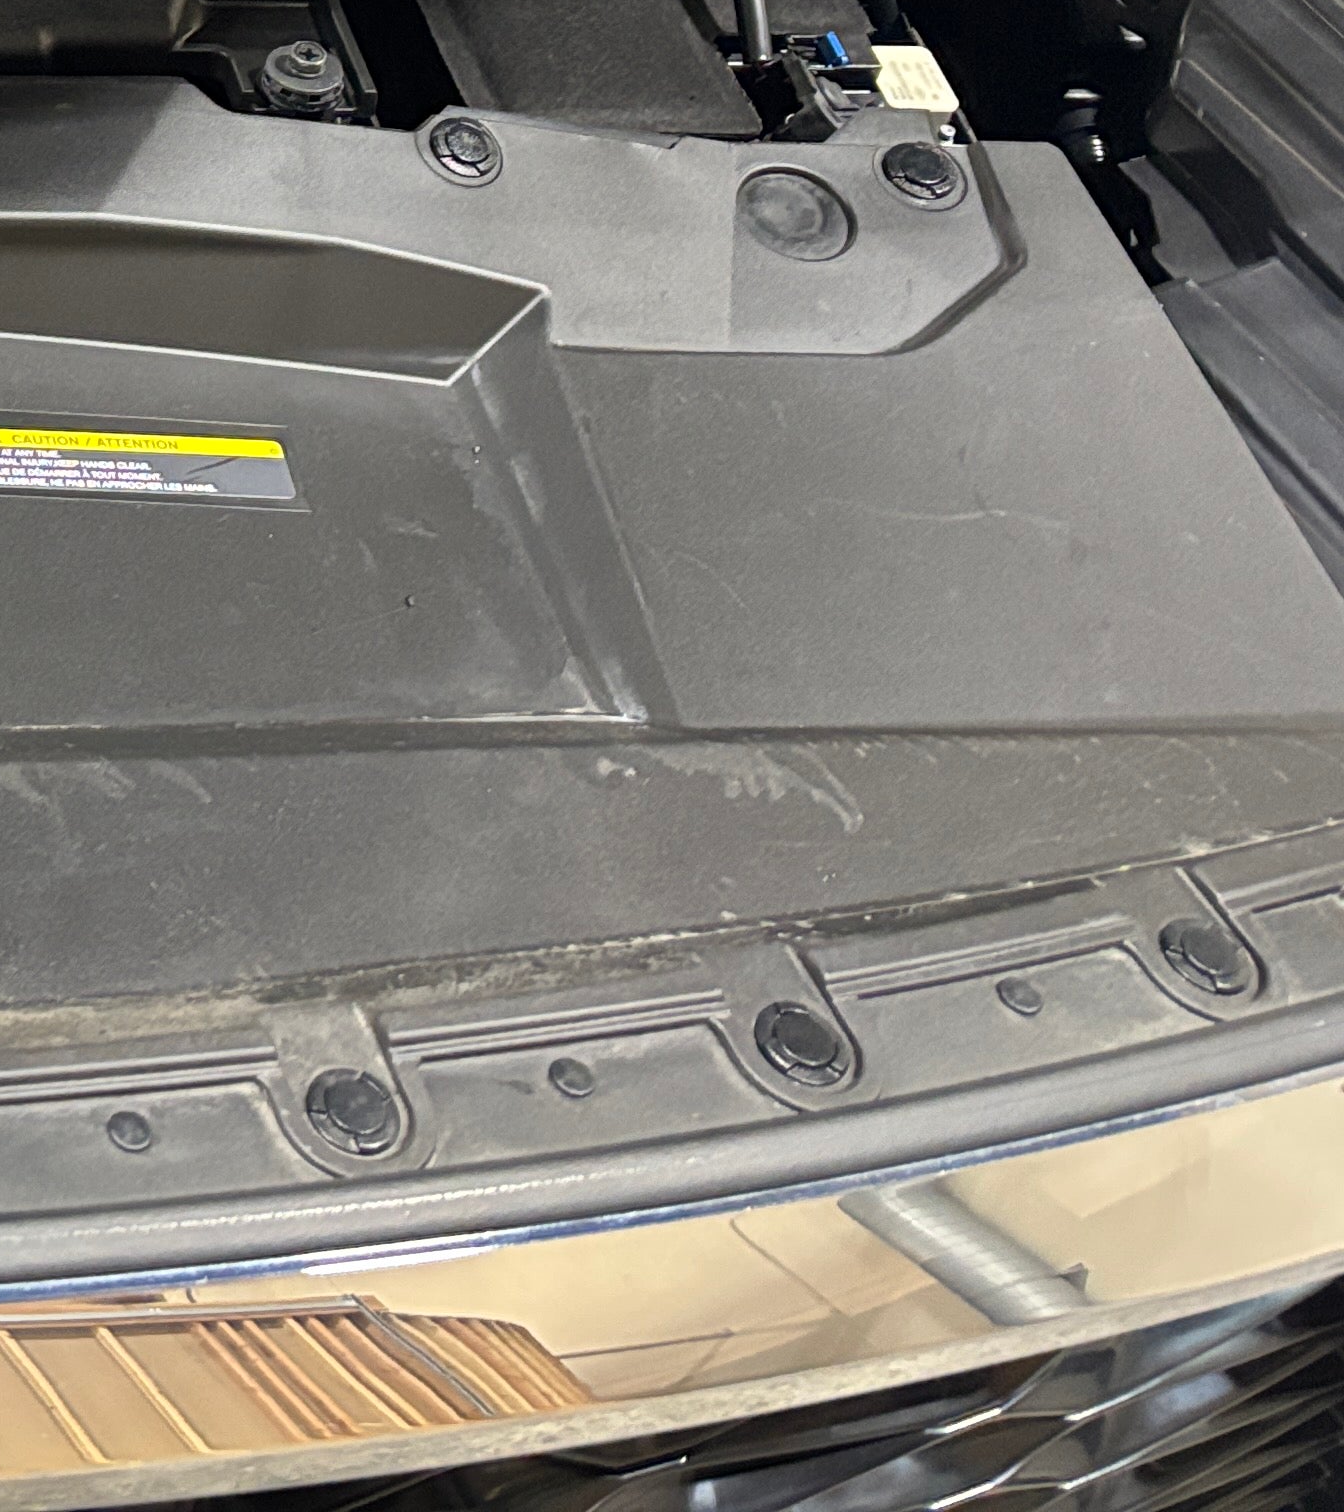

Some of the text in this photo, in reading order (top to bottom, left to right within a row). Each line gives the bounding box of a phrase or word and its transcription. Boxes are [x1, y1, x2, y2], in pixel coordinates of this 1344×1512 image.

[12, 434, 79, 445] CAUTION
[97, 438, 178, 449] ATTENTION
[0, 448, 13, 456] AT
[90, 470, 116, 480] TOUT
